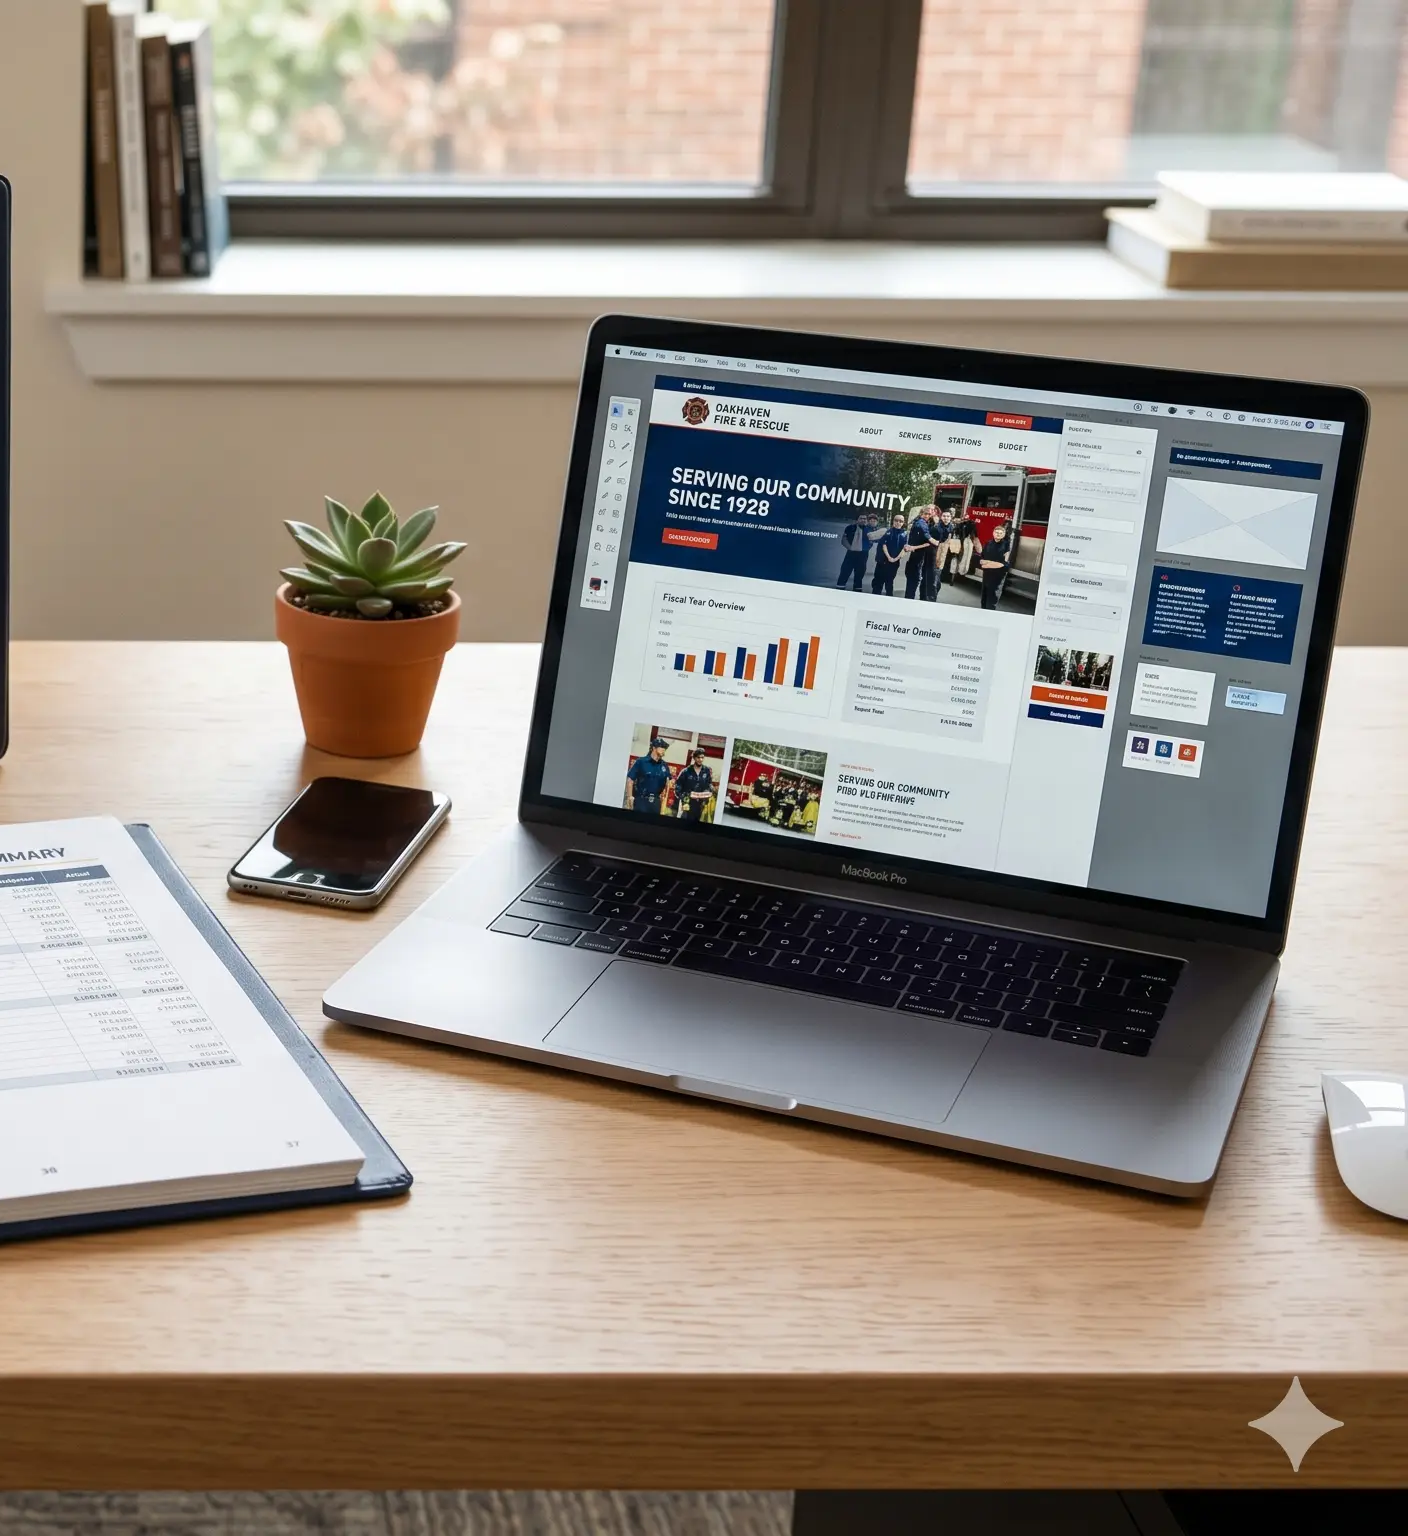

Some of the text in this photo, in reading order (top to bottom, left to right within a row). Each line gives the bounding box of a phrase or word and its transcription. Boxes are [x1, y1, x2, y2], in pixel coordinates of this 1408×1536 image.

[715, 403, 771, 417] OAKHAVEN
[714, 415, 790, 432] FIRE & RESCUE
[859, 427, 883, 436] ABOUT
[898, 431, 932, 442] SERVICES
[948, 436, 982, 447] STATIONS
[998, 442, 1028, 452] BUDGET
[671, 467, 910, 512] SERVING OUR COMMUNITY
[668, 488, 770, 517] SINCE 1928
[663, 593, 745, 612] Fiscal Year Overview
[866, 621, 890, 632] Fiscal
[892, 624, 910, 634] Year
[877, 781, 895, 791] OUR
[897, 783, 950, 799] COMMUNITY
[840, 863, 907, 885] MacBook Pro
